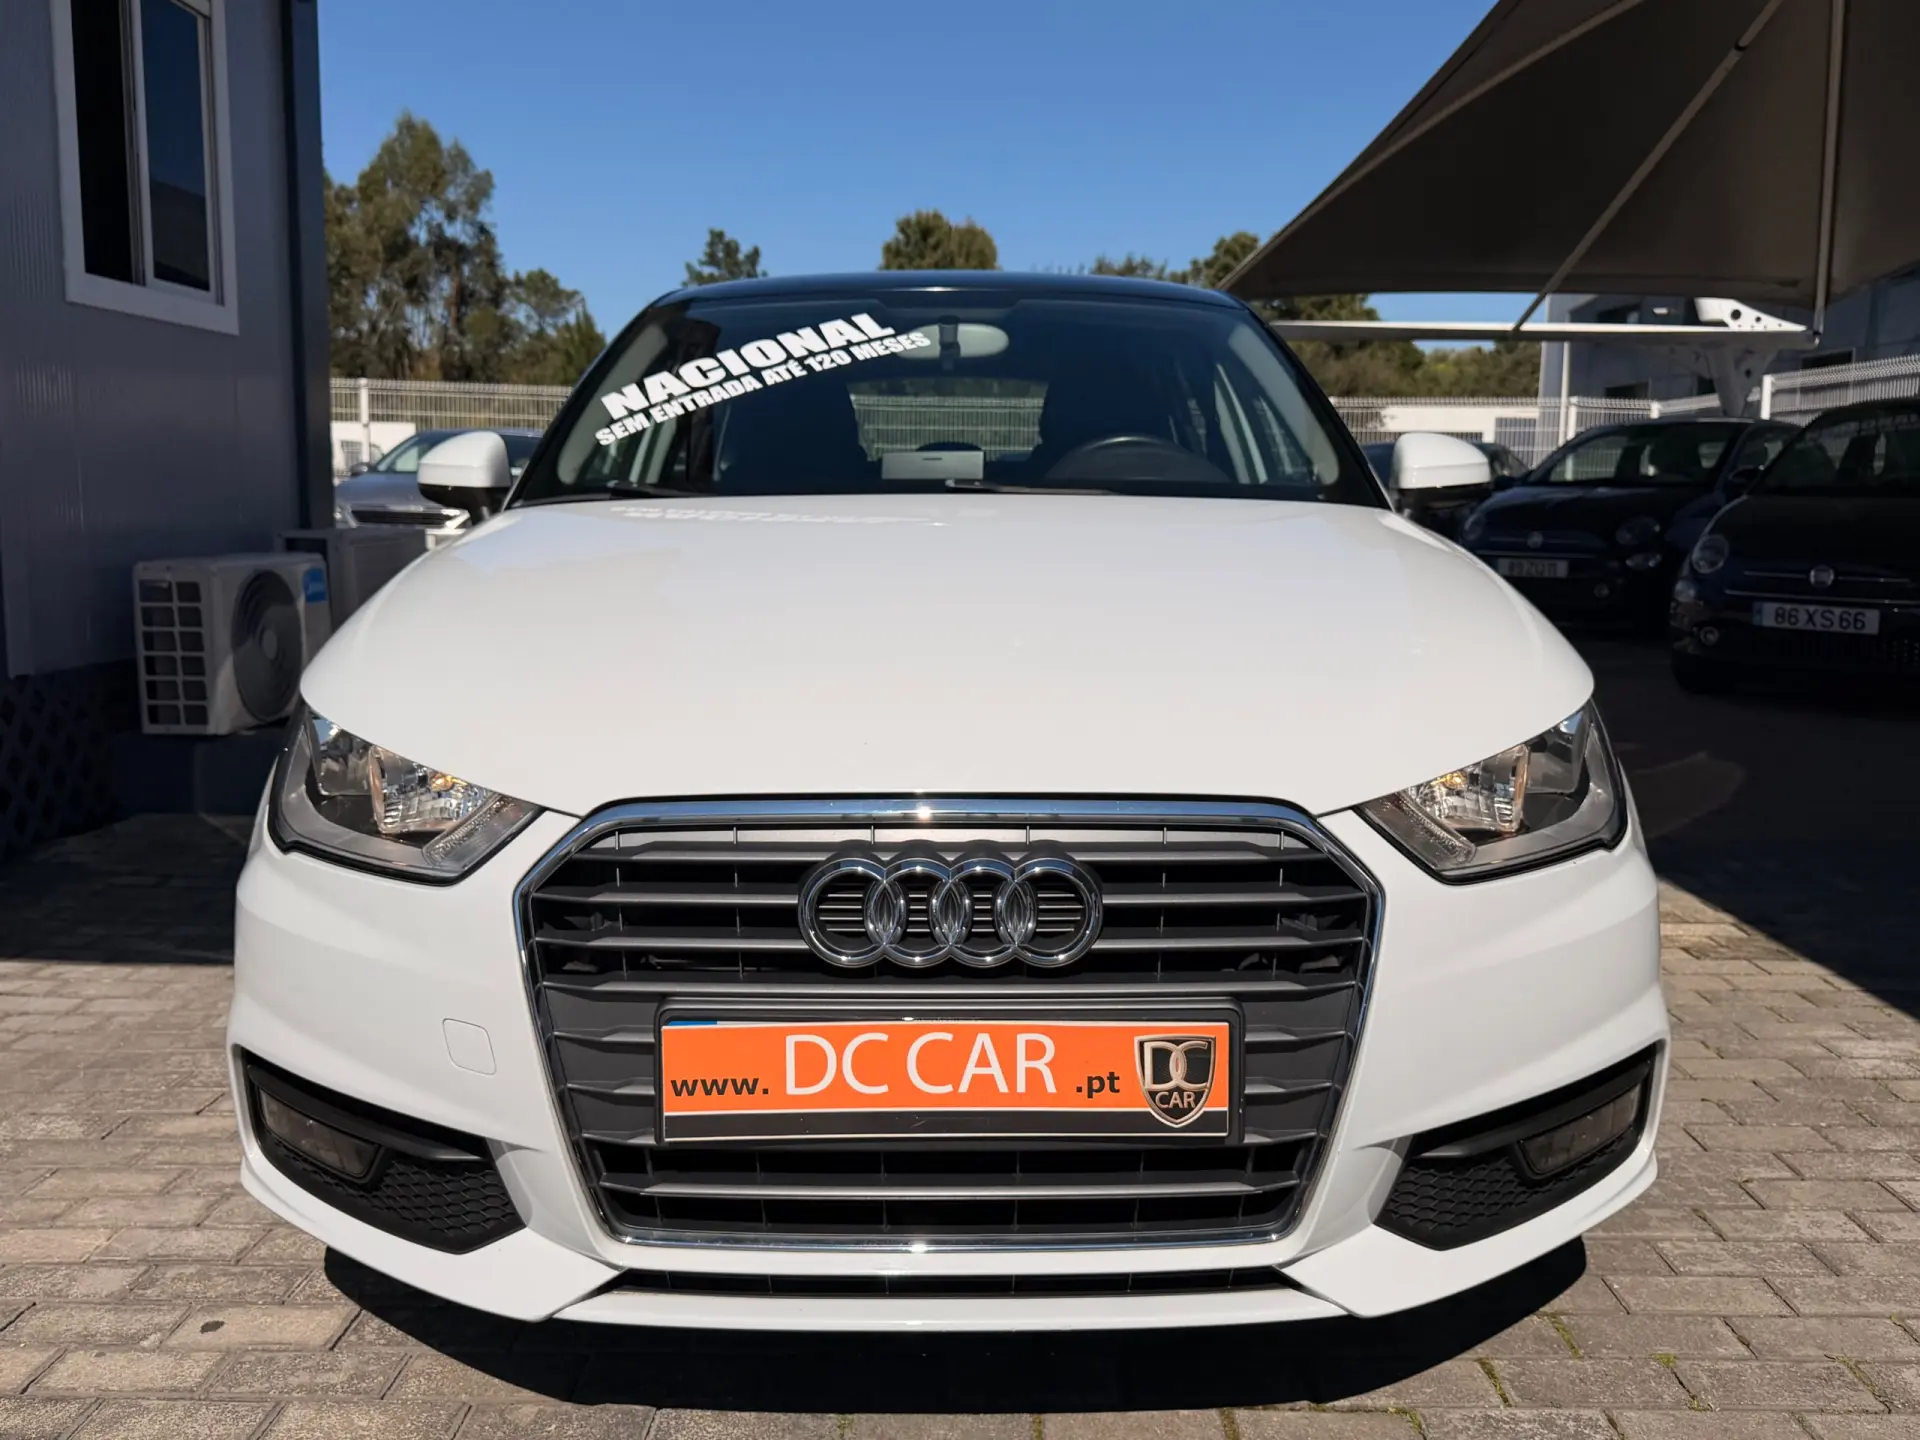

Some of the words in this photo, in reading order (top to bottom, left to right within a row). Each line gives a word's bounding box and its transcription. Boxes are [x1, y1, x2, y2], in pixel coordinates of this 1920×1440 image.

[595, 411, 650, 446] SEM
[650, 375, 763, 423] ENTRADA
[761, 359, 807, 386] ATÉ
[806, 349, 851, 374] 120
[850, 332, 931, 362] MESES
[601, 313, 895, 420] NACIONAL
[670, 1077, 769, 1097] www.
[785, 1032, 889, 1096] DC
[906, 1032, 1057, 1095] CAR
[1076, 1071, 1120, 1098] .pt
[1143, 1040, 1209, 1091] DC
[1155, 1091, 1196, 1109] CAR
